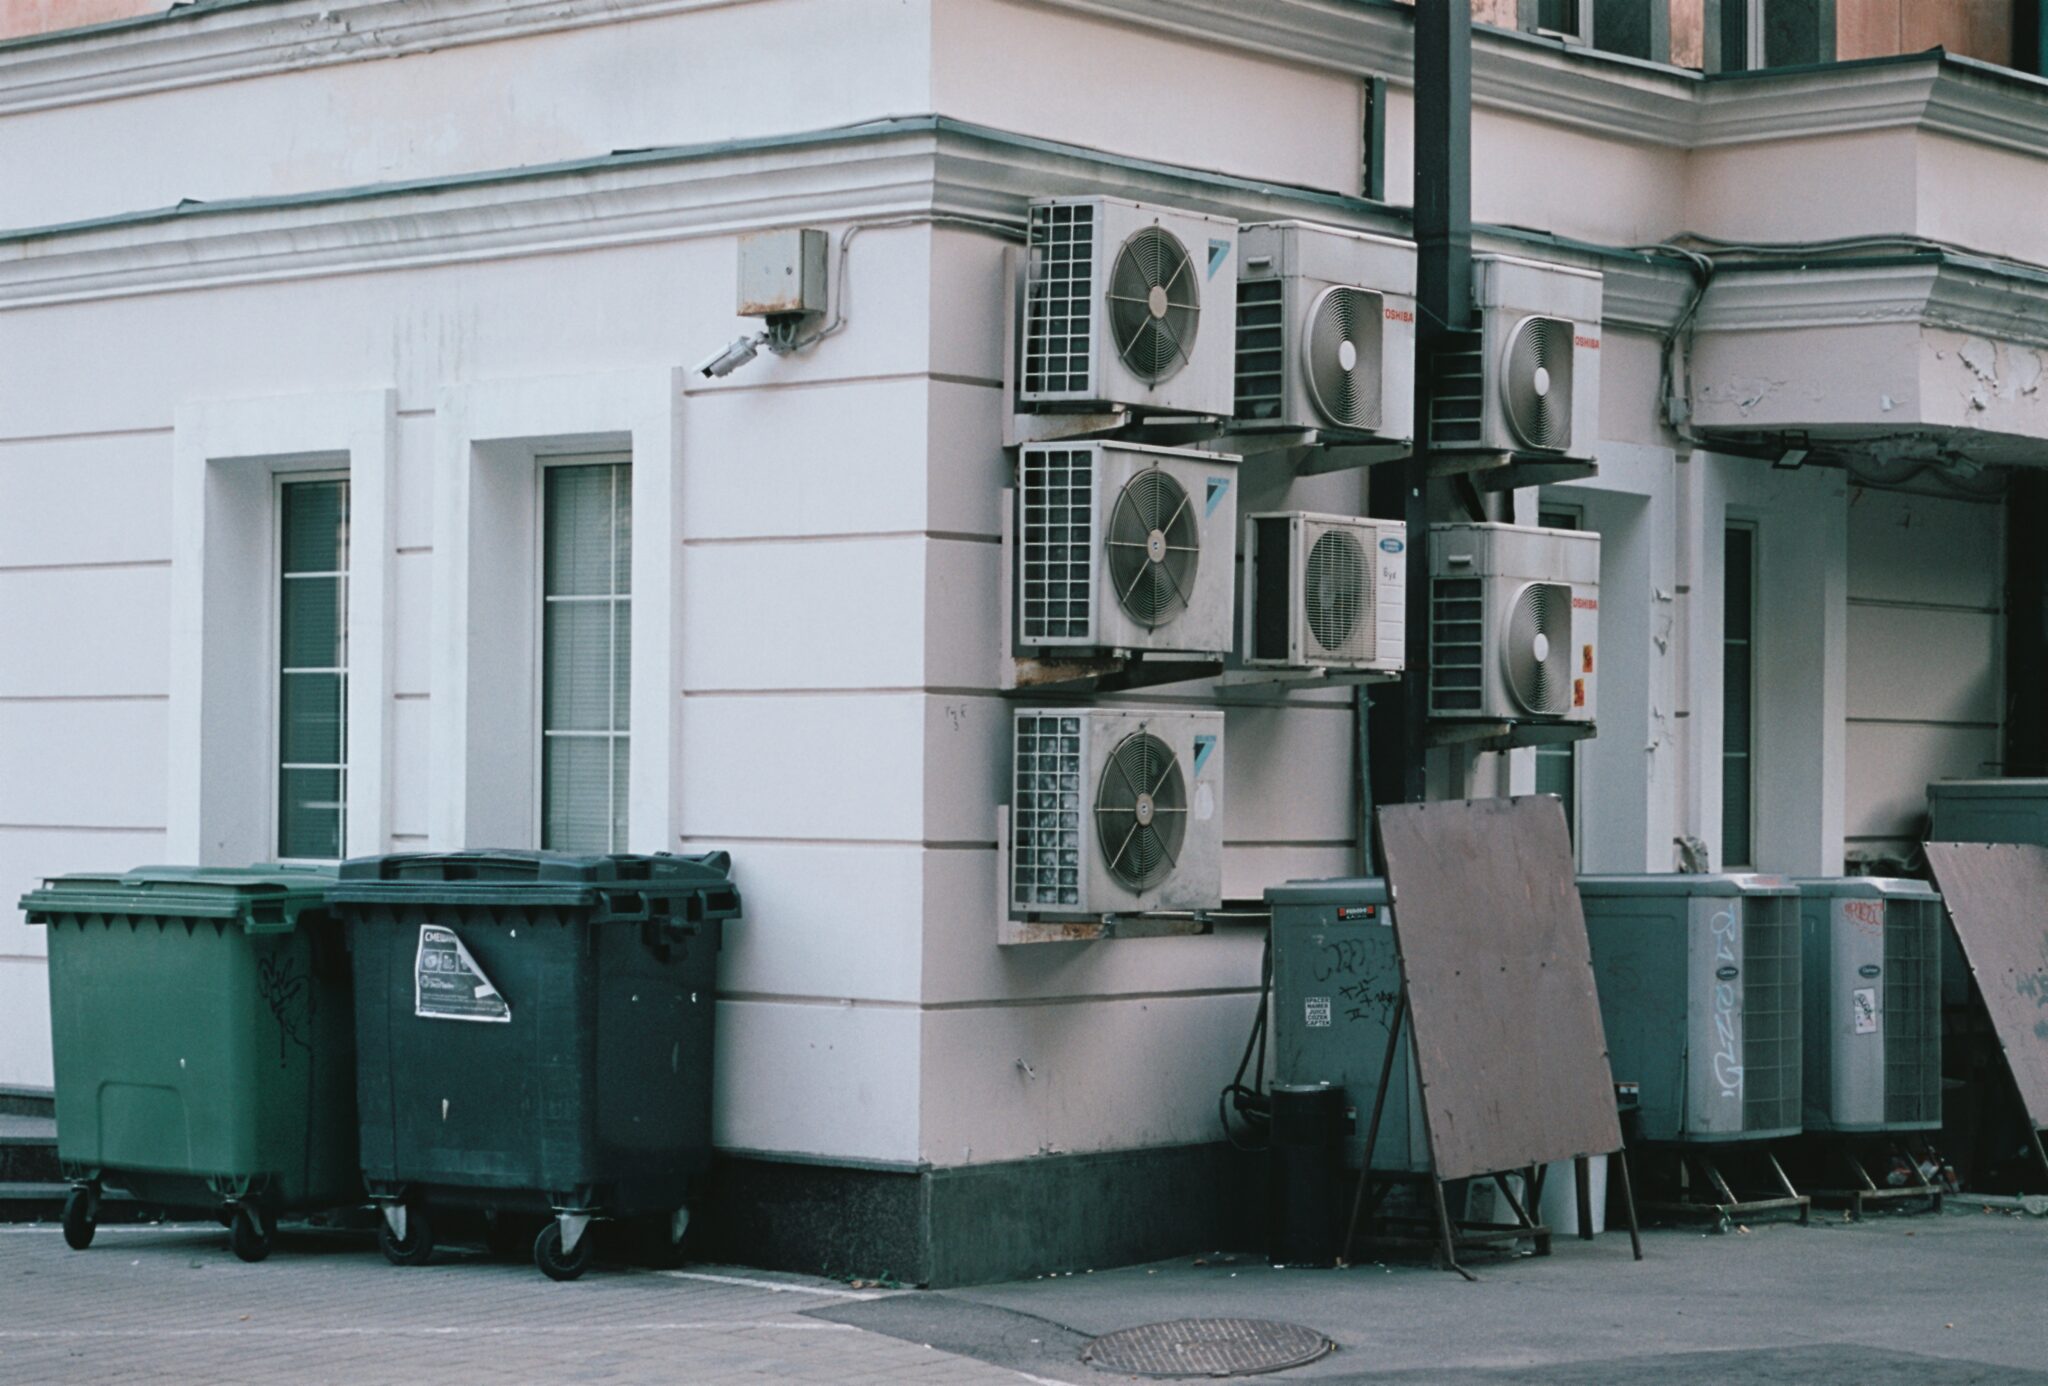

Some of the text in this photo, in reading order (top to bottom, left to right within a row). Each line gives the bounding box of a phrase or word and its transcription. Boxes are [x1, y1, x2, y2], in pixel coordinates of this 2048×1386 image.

[1384, 308, 1414, 323] OSHIBA
[1574, 335, 1600, 349] OSHIBA
[1572, 598, 1598, 610] OSHIBA
